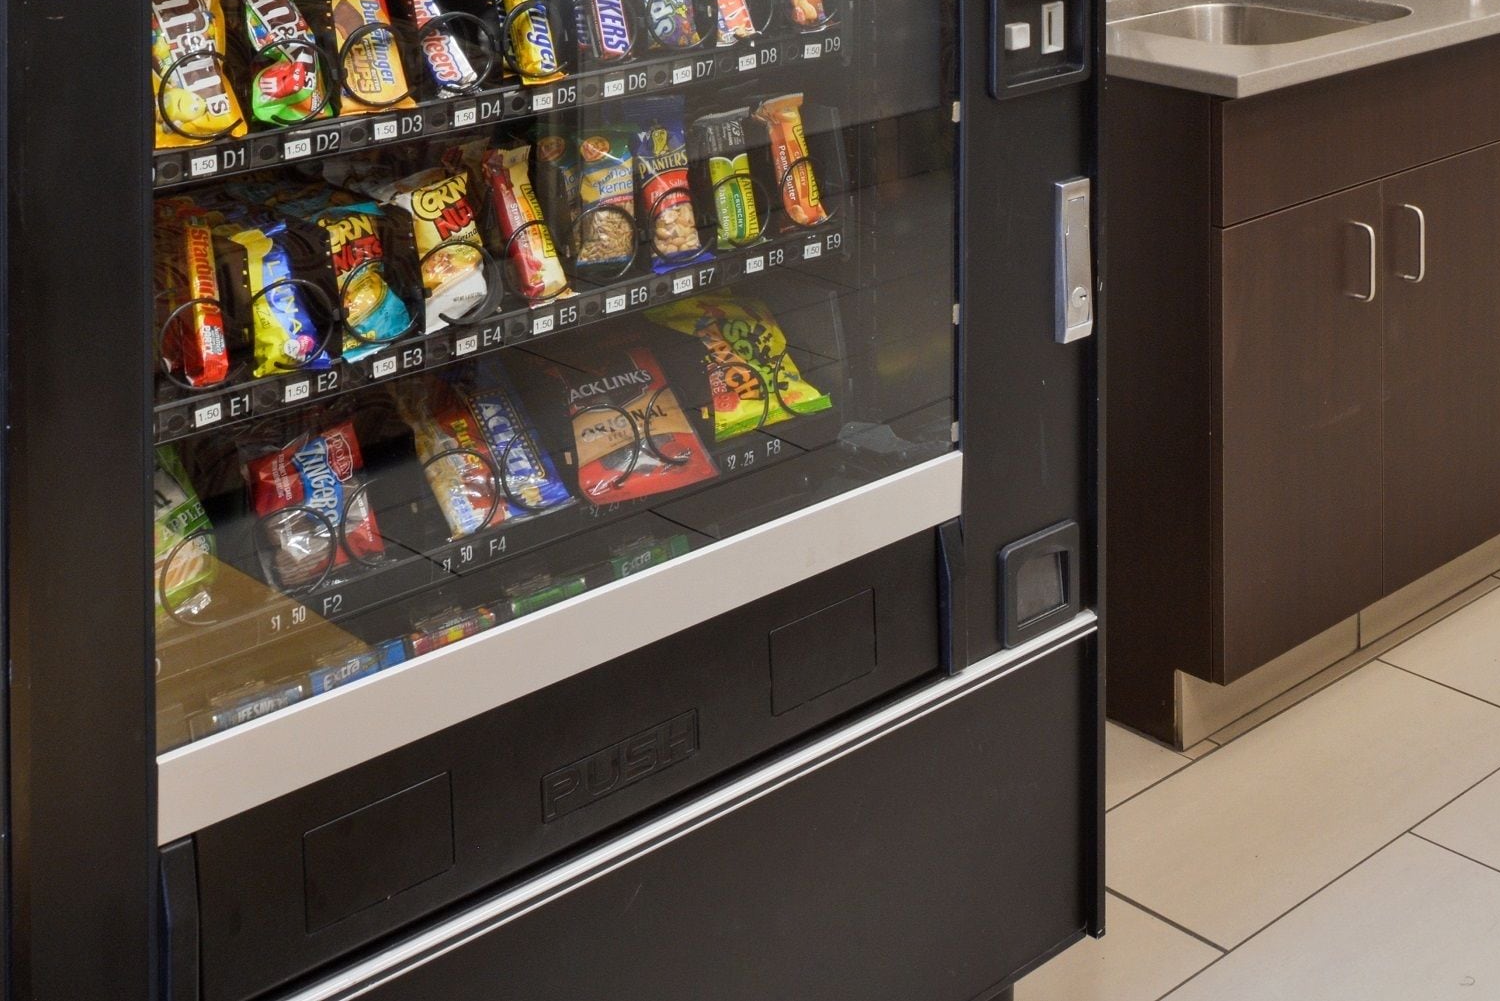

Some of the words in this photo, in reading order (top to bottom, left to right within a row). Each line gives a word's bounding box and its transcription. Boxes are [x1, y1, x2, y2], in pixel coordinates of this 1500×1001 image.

[805, 46, 820, 55] 1.50
[825, 37, 841, 53] D9
[740, 58, 755, 67] 1.50
[761, 48, 777, 65] D8
[675, 70, 690, 80] 1.50
[696, 60, 714, 78] D7
[606, 83, 622, 93] 1.50
[628, 72, 647, 91] D6
[535, 96, 551, 106] 1.50
[558, 87, 576, 104] D5
[456, 111, 474, 122] 1.50
[481, 101, 501, 119] D4
[376, 124, 395, 135] 1.50
[402, 115, 423, 134] D3
[286, 142, 307, 154] 1.50
[316, 133, 339, 152] D2
[193, 158, 215, 172] 1.50
[223, 148, 245, 168] D1
[638, 150, 688, 180] PLANTERS
[411, 171, 469, 222] CORN
[805, 246, 820, 256] 1.50
[826, 234, 841, 250] E9
[747, 259, 763, 269] 1.50
[769, 249, 784, 266] E8
[676, 279, 691, 290] 1.50
[699, 269, 715, 287] E7
[607, 298, 624, 309] 1.50
[631, 287, 648, 305] E6
[535, 319, 552, 330] 1.50
[560, 307, 577, 325] E5
[458, 338, 476, 350] 1.50
[483, 327, 502, 347] E4
[374, 361, 395, 373] 1.50
[403, 348, 422, 369] E3
[288, 385, 308, 398] 1.50
[317, 371, 338, 393] E2
[569, 380, 606, 404] ACK
[605, 369, 652, 391] LINK'S
[199, 408, 220, 422] 1.50
[230, 394, 249, 417] E1
[581, 405, 668, 443] ORIGNAL
[766, 438, 781, 457] F8
[161, 500, 205, 541] APPLE
[489, 536, 506, 557] F4
[322, 594, 343, 616] F2
[323, 658, 360, 691] Extra
